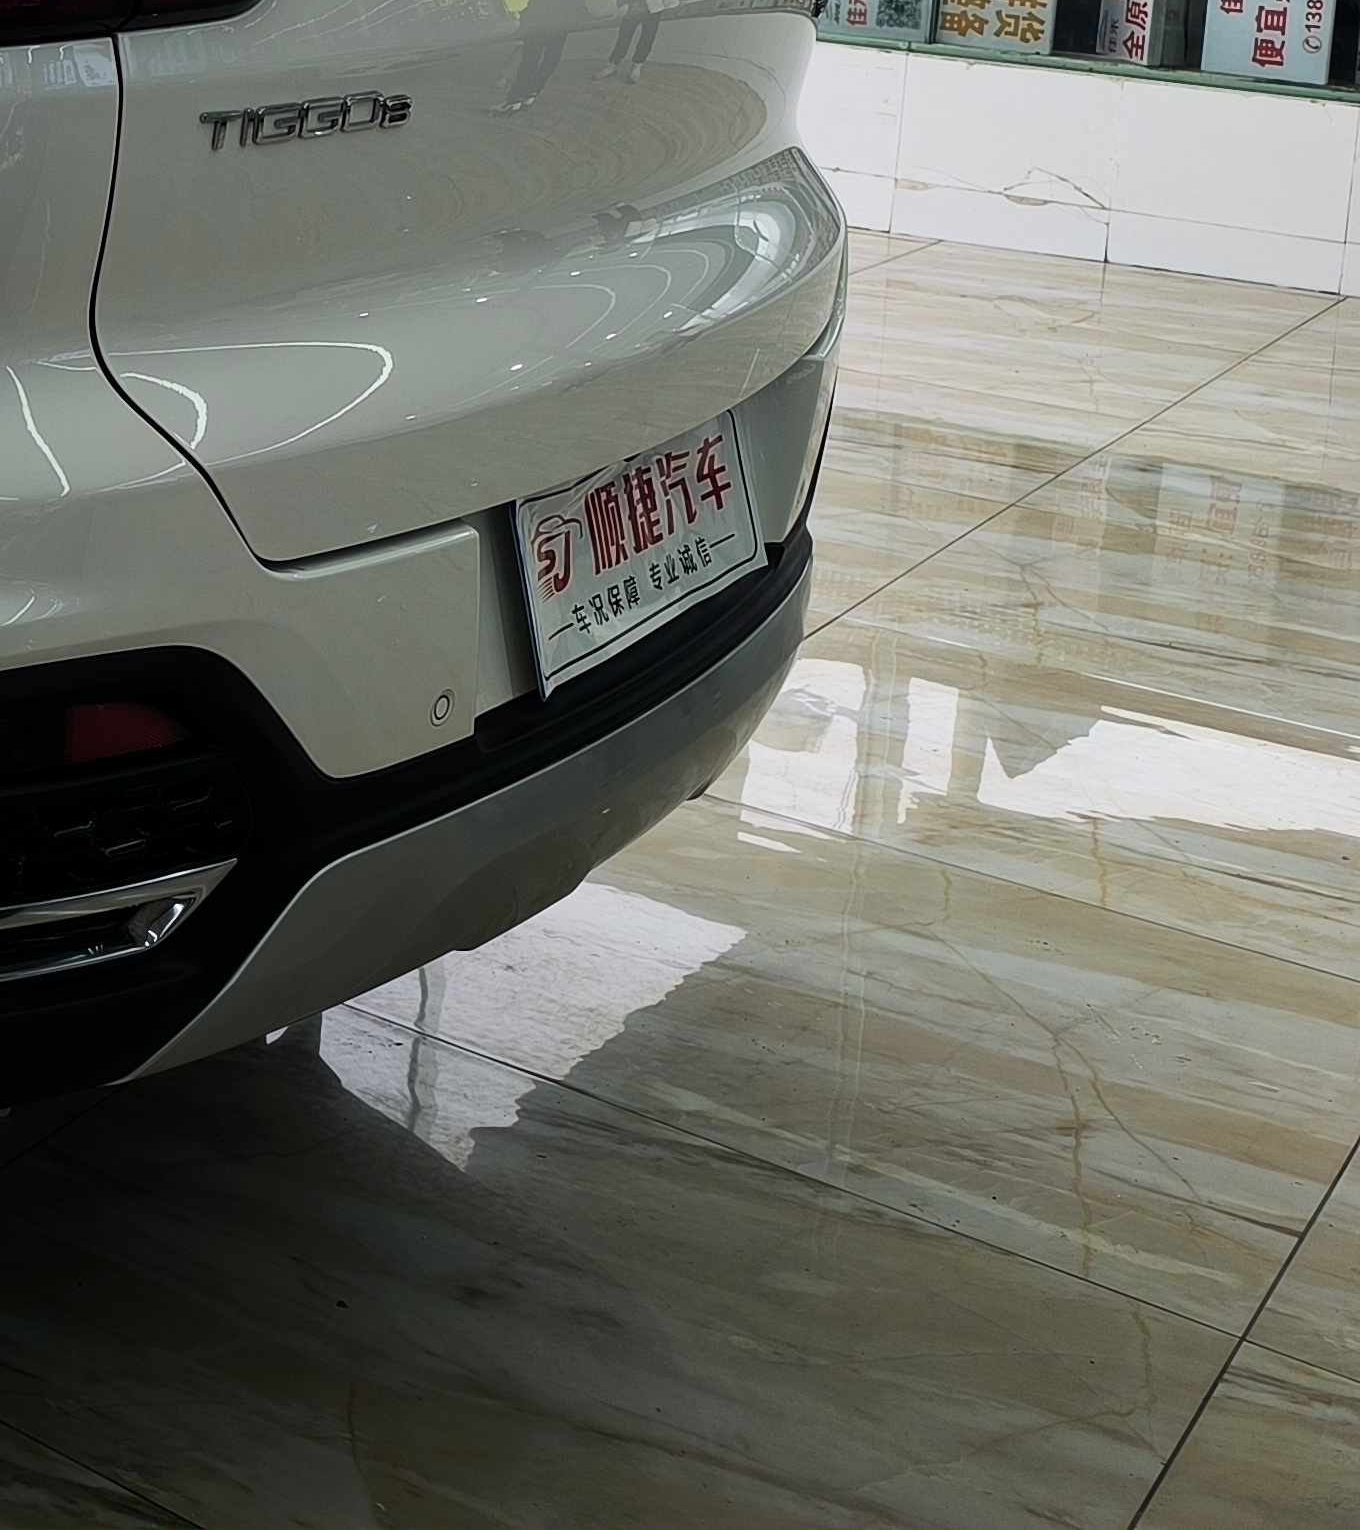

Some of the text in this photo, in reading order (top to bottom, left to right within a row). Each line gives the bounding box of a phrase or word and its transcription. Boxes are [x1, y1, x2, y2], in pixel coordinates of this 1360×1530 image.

[1304, 0, 1324, 33] 138
[583, 434, 732, 577] 顺捷汽车
[571, 536, 714, 635] 车况保障 专业诚信
